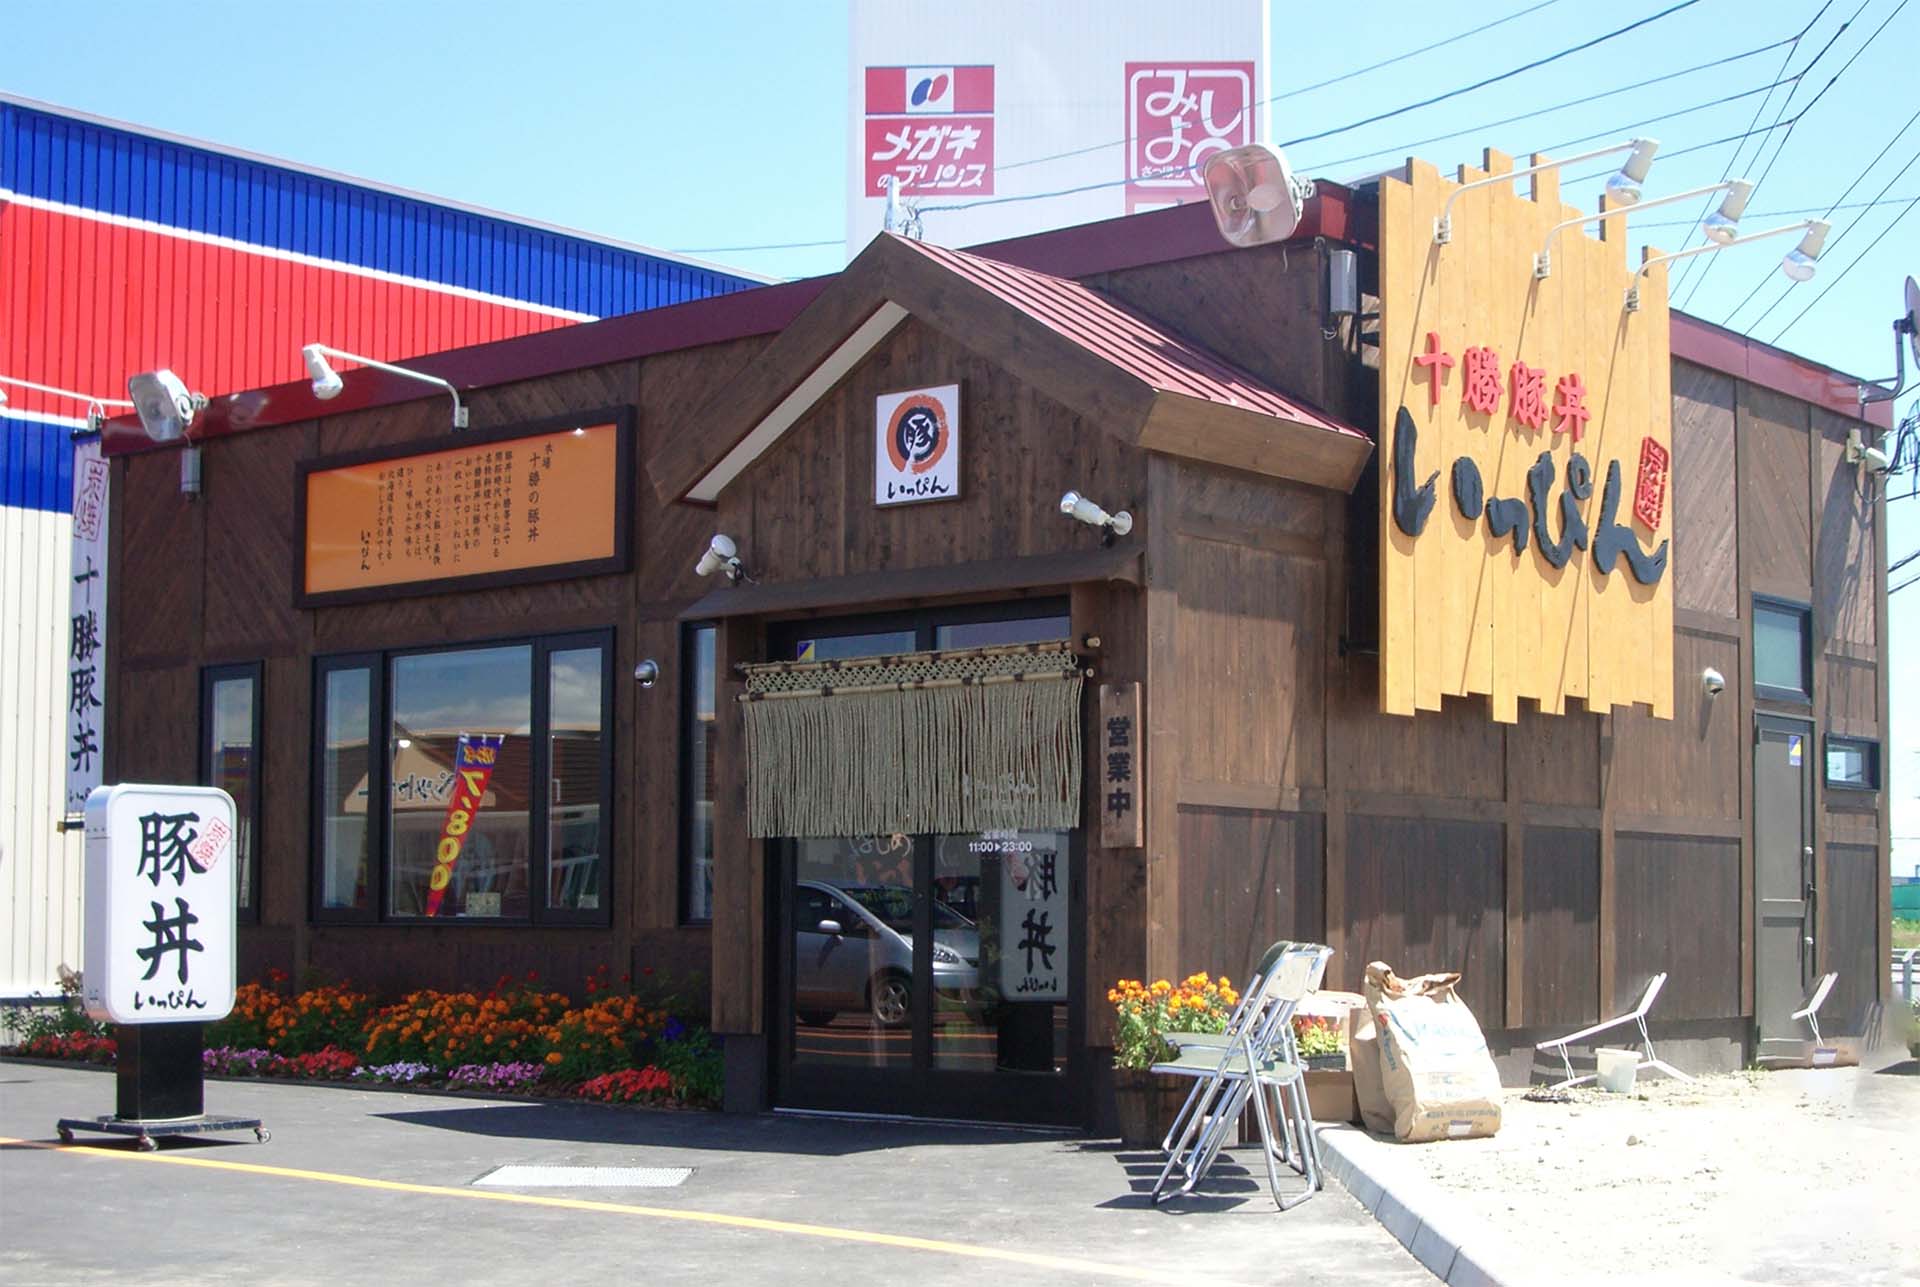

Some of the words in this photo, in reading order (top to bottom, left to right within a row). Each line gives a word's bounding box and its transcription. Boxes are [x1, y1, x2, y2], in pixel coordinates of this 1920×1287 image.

[872, 126, 981, 160] メガネ
[1414, 332, 1591, 443] 十勝豚丼
[888, 476, 949, 499] いっぴん
[1393, 406, 1669, 584] いっぴん
[70, 556, 102, 773] 十勝豚丼
[1107, 716, 1131, 818] 営業中
[136, 812, 207, 985] 豚丼
[134, 990, 207, 1010] いっぴん
